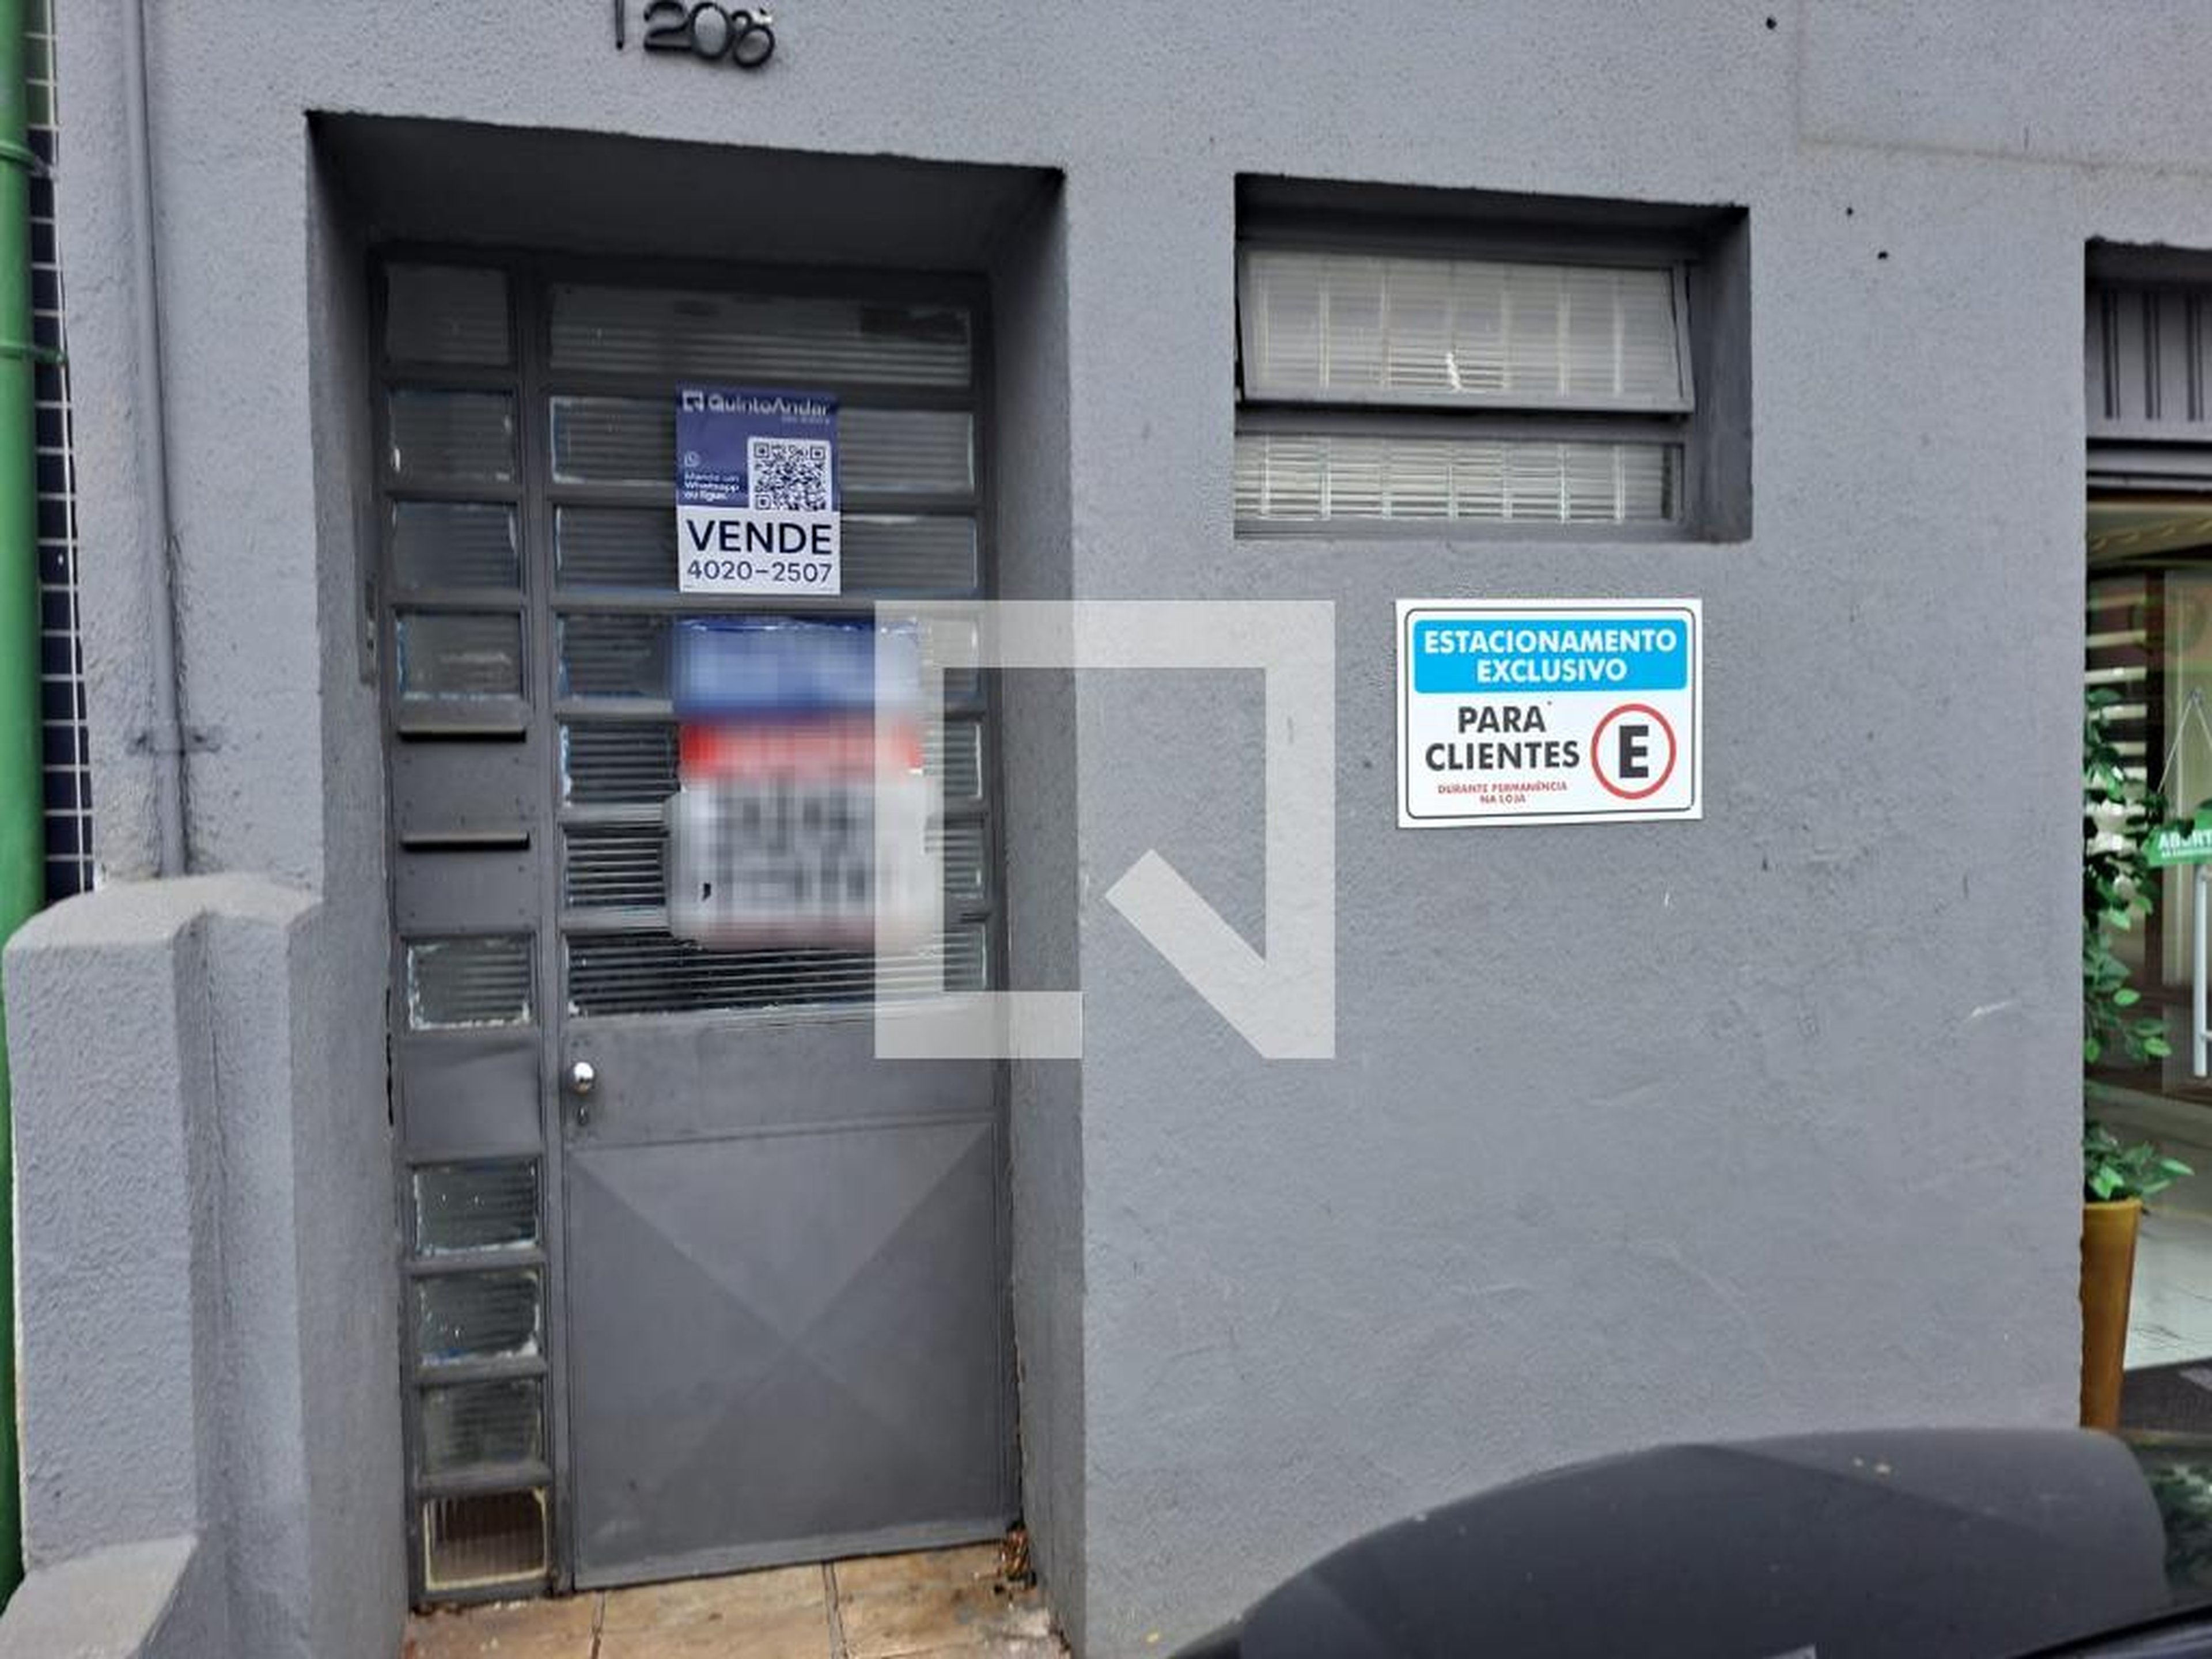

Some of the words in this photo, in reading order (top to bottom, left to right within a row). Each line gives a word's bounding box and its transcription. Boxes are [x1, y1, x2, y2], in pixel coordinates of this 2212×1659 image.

[687, 519, 832, 555] VENDE
[687, 560, 832, 582] 4020-2507
[1424, 628, 1677, 653] ESTACIONAMENTO
[1477, 658, 1627, 683] EXCLUSIVO
[1458, 706, 1546, 733] PARA
[1426, 740, 1580, 771] CLIENTES
[1619, 725, 1649, 778] E
[1438, 783, 1488, 794] DURANTE
[1479, 795, 1497, 804] NA
[1499, 794, 1527, 804] LOJA
